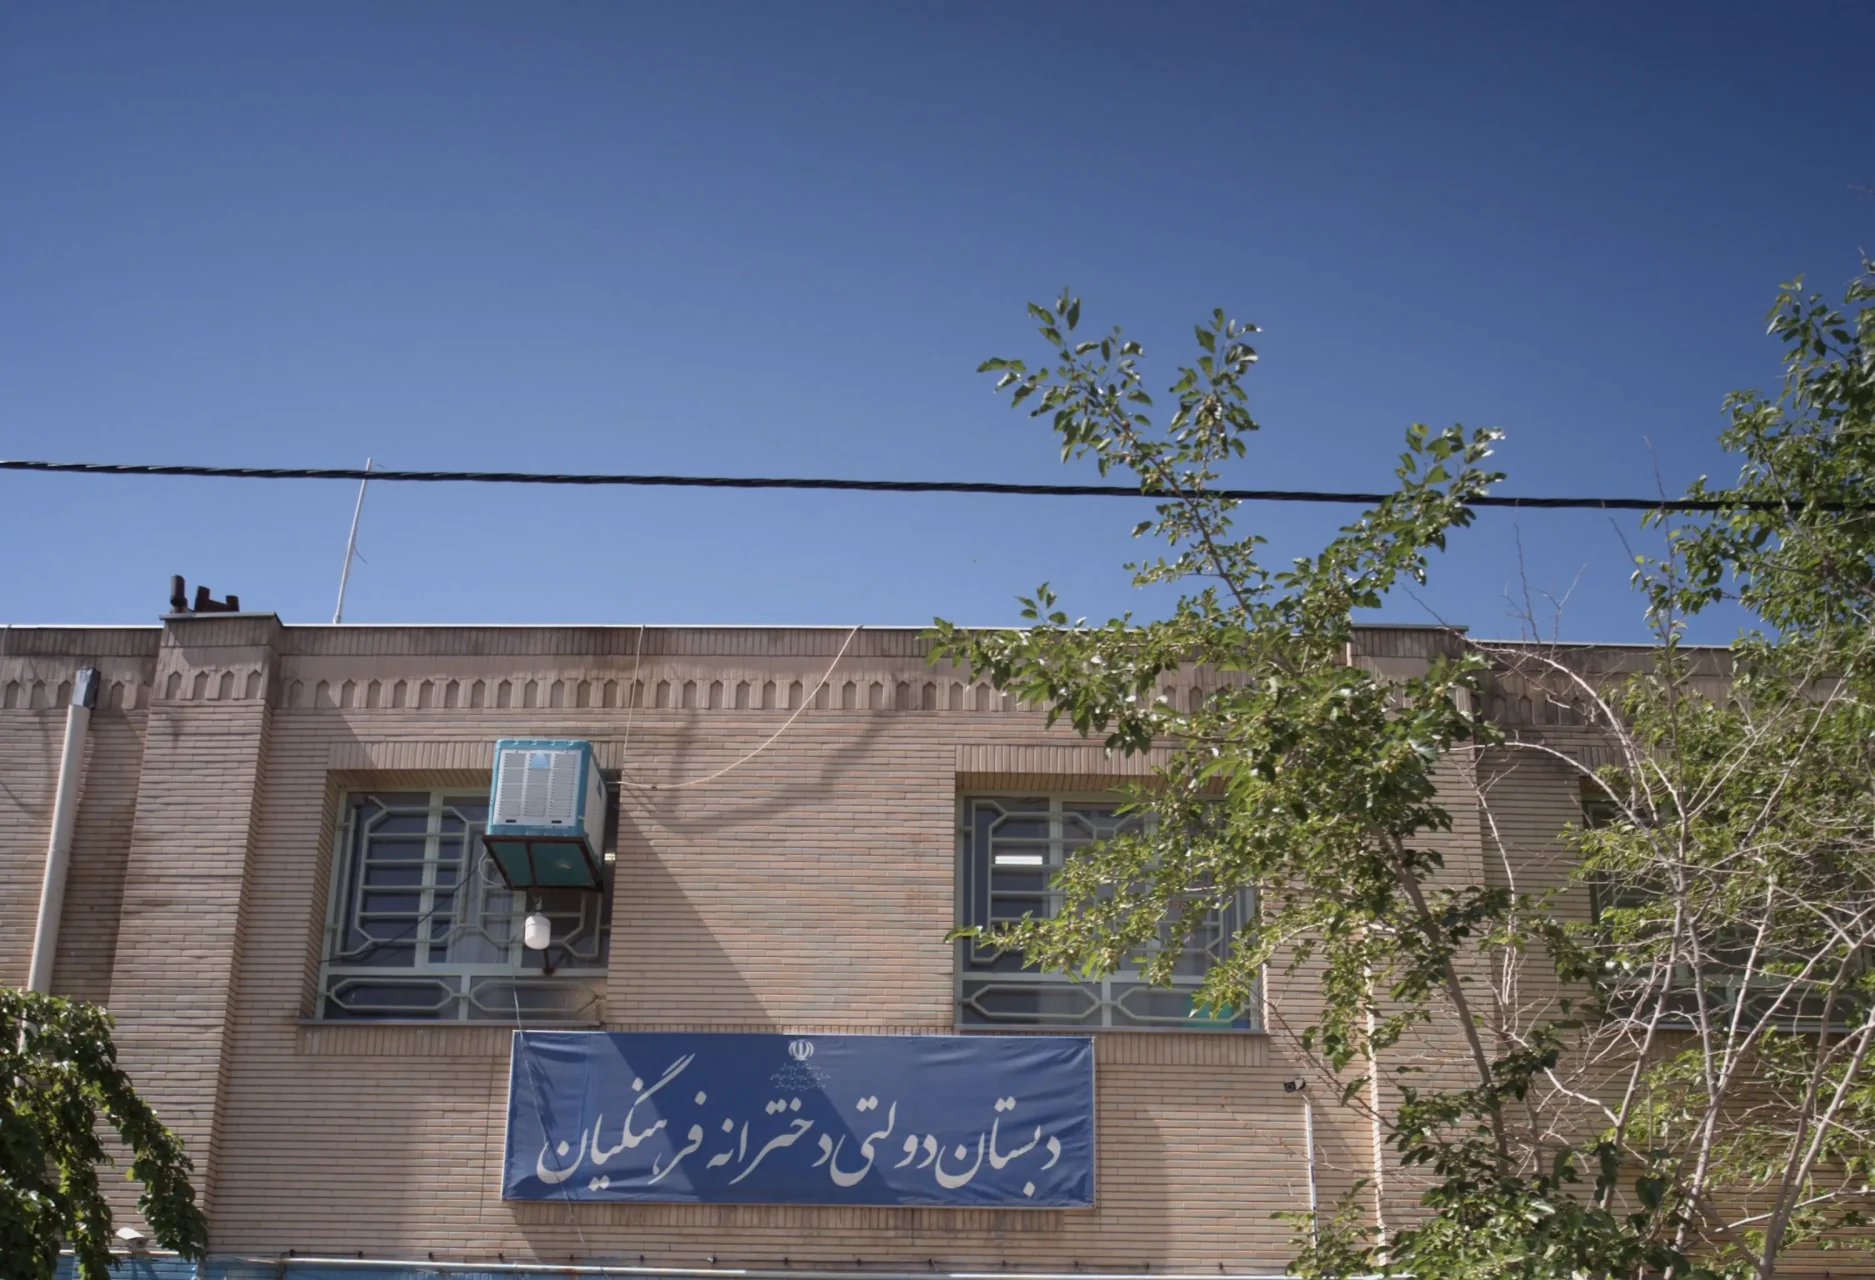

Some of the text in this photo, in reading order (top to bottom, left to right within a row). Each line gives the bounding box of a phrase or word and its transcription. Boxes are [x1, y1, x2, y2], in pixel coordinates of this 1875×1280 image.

[535, 1052, 1061, 1197] دبستان دولتی دخترانه فرهنگیان
